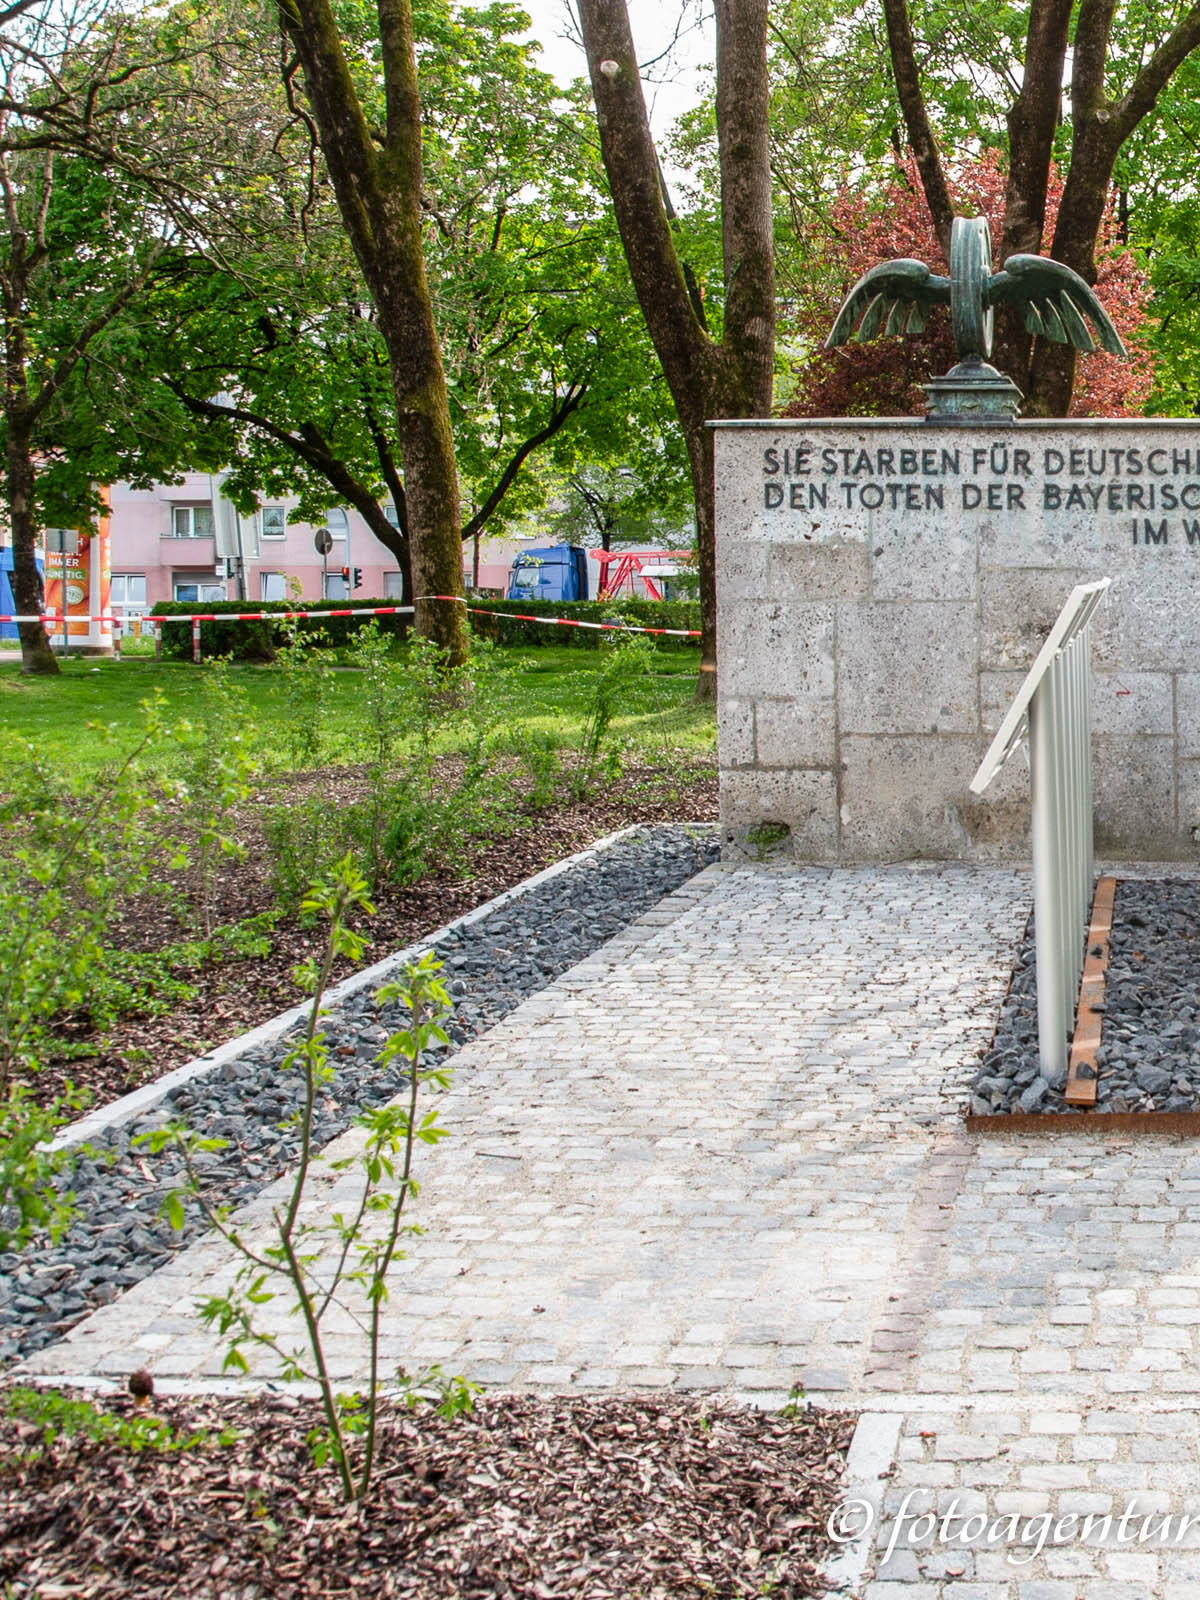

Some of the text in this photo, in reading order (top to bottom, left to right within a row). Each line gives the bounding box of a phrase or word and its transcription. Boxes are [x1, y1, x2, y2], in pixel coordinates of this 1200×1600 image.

[763, 447, 811, 475] SIE
[821, 448, 960, 475] STARBEN
[972, 442, 1032, 475] FÜR
[764, 483, 828, 510] DEN
[840, 483, 944, 510] TOTEN
[961, 483, 1026, 510] DER
[1132, 518, 1169, 545] IM
